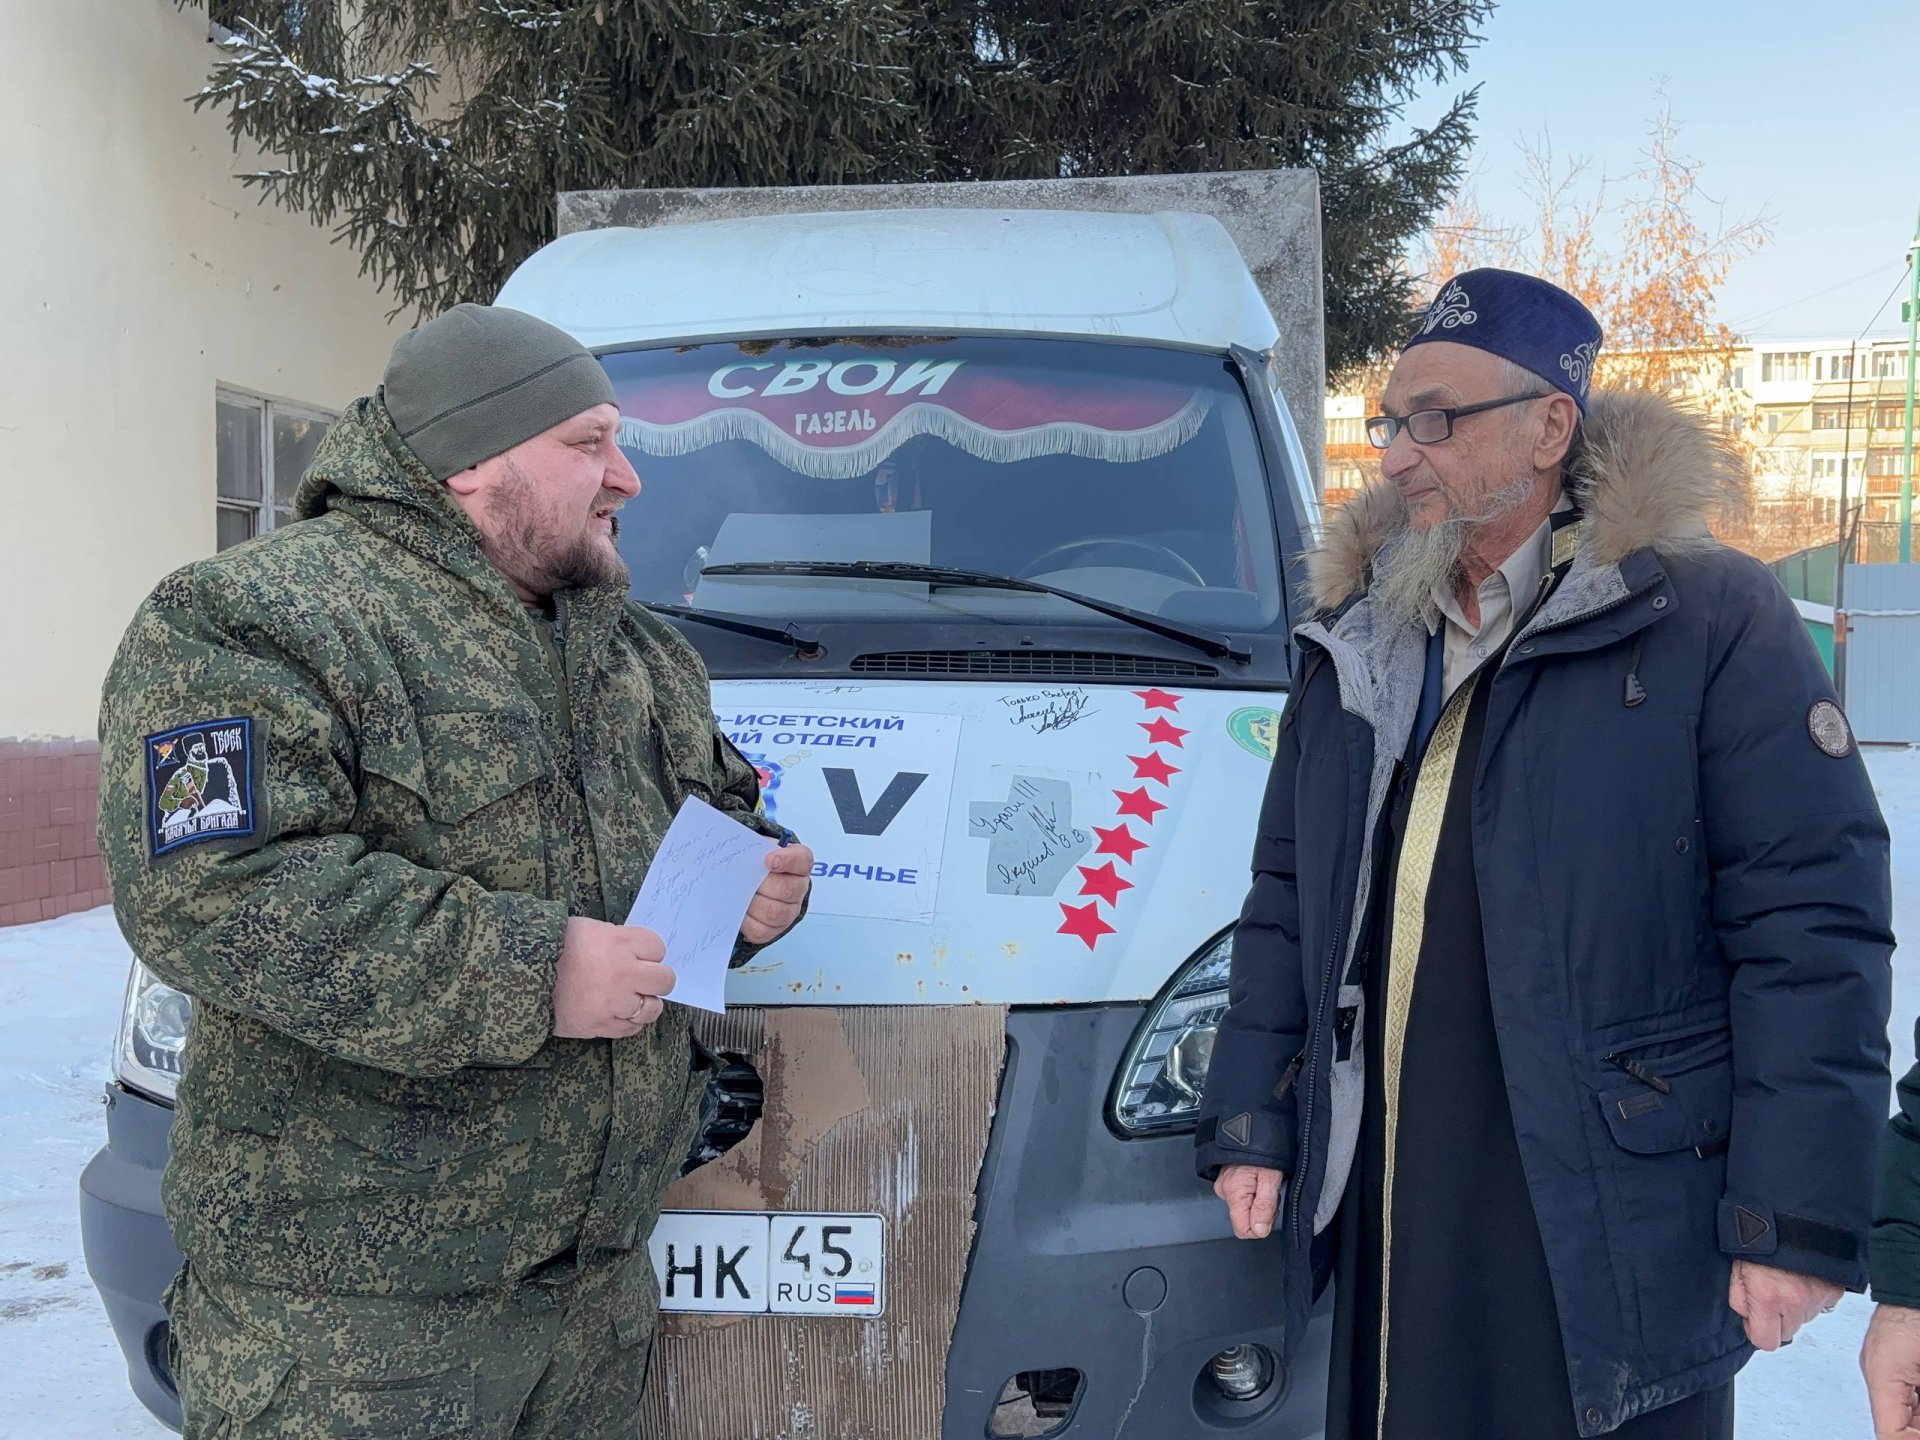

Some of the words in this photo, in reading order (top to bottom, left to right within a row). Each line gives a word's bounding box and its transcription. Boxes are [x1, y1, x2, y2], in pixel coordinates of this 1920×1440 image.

[707, 357, 969, 399] СВОИ
[794, 408, 878, 436] ГАЗЕЛЬ
[210, 727, 243, 755] ТЕРЕК
[772, 732, 877, 748] ОТДЕЛ
[821, 767, 930, 837] V
[164, 818, 197, 843] КАЗАЧЬЯ
[200, 812, 239, 831] БРИГАДА
[811, 862, 918, 884] ЗАЧЬЕ
[781, 1225, 853, 1279] 45
[777, 1282, 832, 1303] RUS
